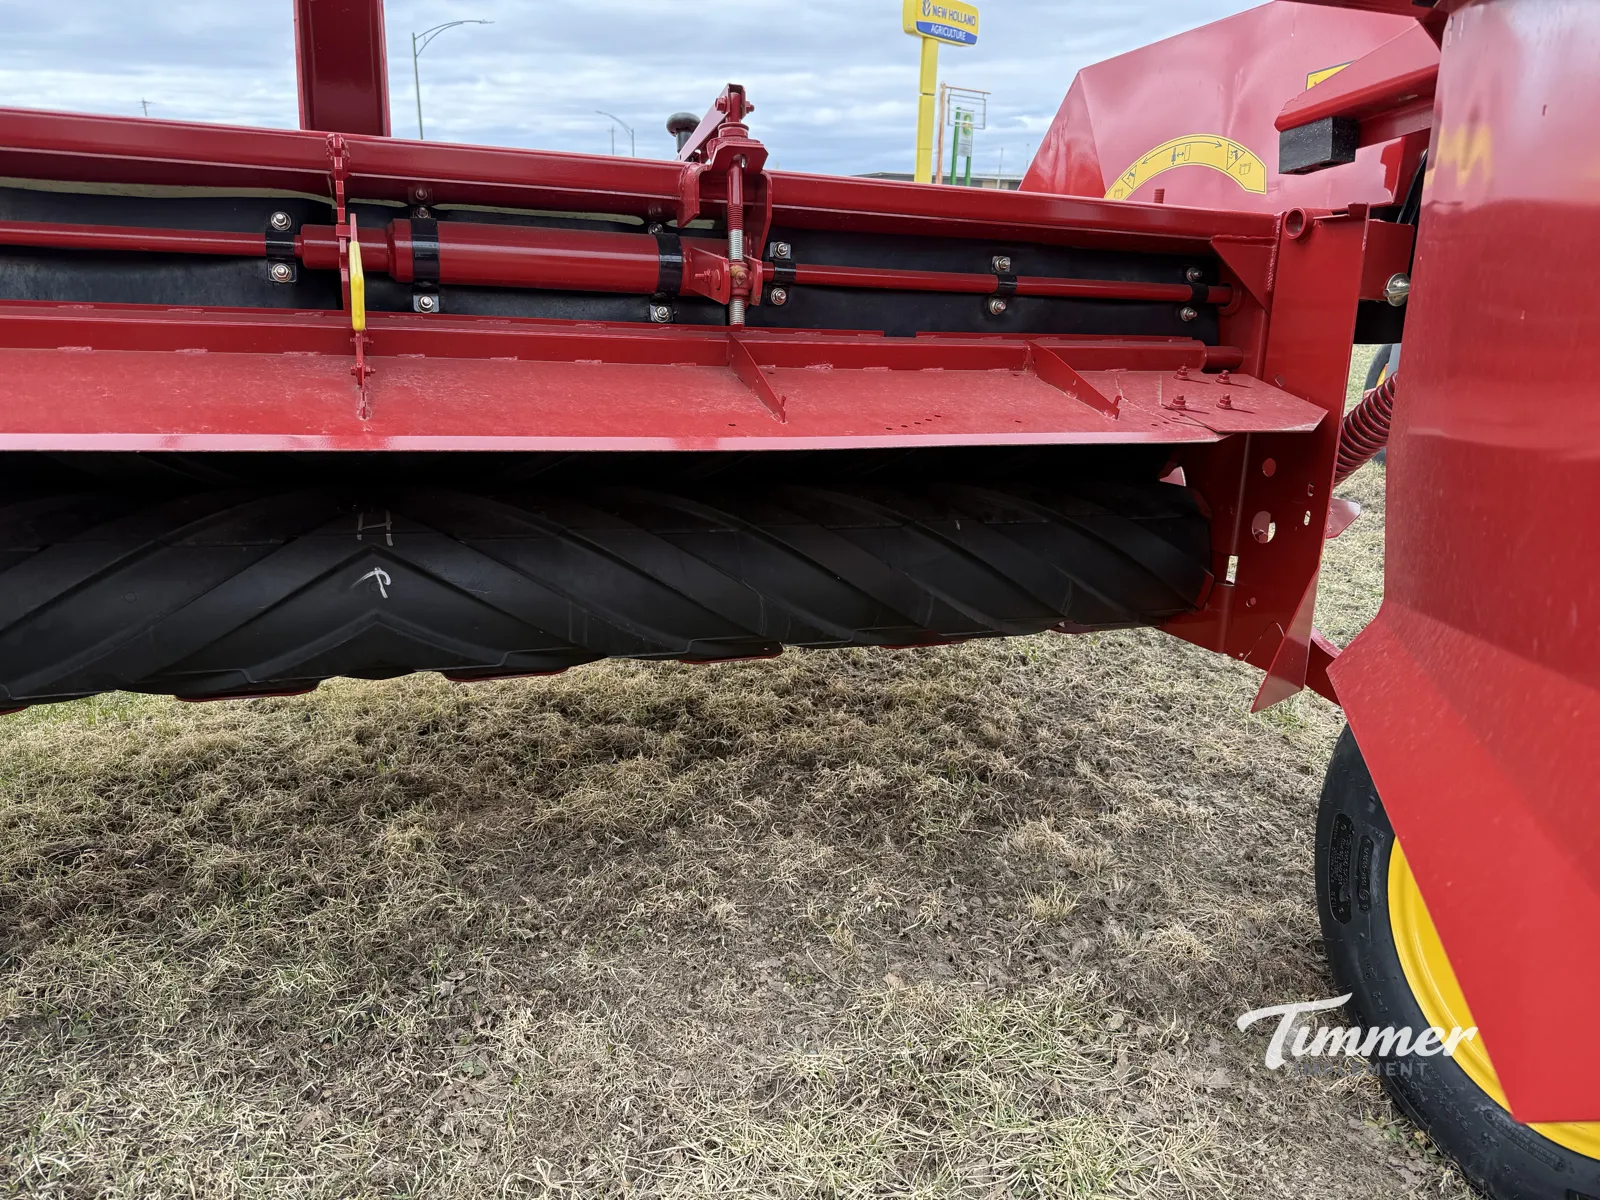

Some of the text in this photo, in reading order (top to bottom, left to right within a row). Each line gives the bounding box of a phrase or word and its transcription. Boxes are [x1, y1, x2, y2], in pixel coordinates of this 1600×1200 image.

[932, 6, 976, 26] NEW HOLLAND
[931, 25, 966, 40] AGRICULTURE
